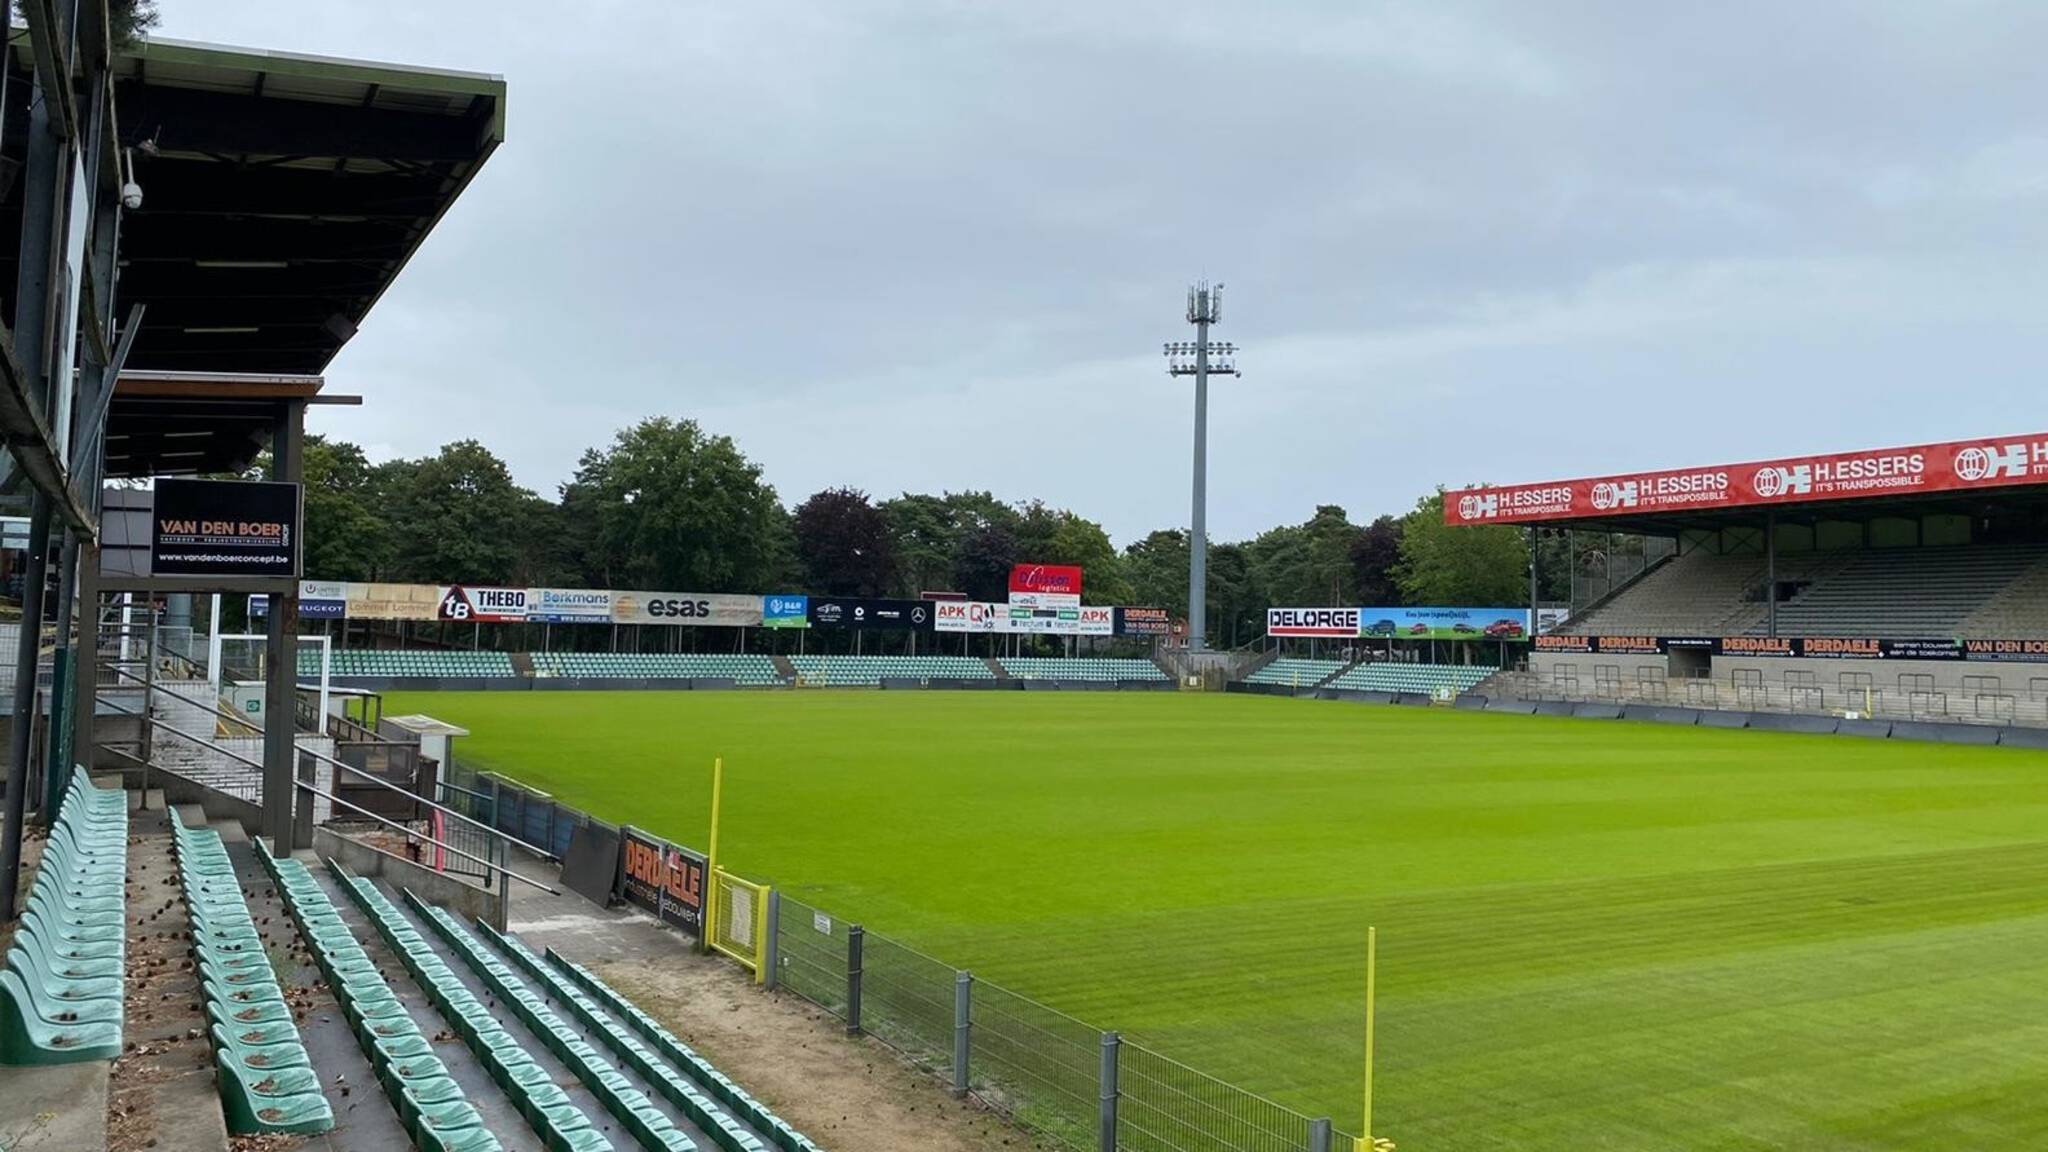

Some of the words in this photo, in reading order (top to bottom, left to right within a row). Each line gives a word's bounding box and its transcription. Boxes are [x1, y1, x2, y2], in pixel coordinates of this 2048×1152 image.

[1815, 454, 1924, 481] H.ESSERS
[1641, 473, 1728, 495] H.ESSERS
[1815, 482, 1833, 492] IT'S
[1836, 475, 1924, 490] TRANSPOSSIBLE.
[1500, 487, 1572, 507] H.ESSERS
[1641, 495, 1655, 506] IT'S
[160, 520, 196, 534] VAN
[201, 521, 234, 535] DEN
[239, 522, 281, 536] BOER
[159, 552, 289, 564] www.vandenboerconcept.be
[477, 591, 525, 607] THEBO
[543, 591, 609, 604] Berkmans
[648, 599, 710, 617] esas
[938, 606, 965, 617] APK
[1081, 611, 1109, 620] APK
[1270, 611, 1358, 627] DELORGE
[1535, 637, 1589, 647] DERDAELE
[1598, 637, 1657, 648] DERDAELE
[1722, 638, 1790, 650] DERDAELE
[1804, 639, 1879, 652] DERDAELE
[1967, 641, 1993, 652] VAN
[1995, 641, 2021, 652] DEN
